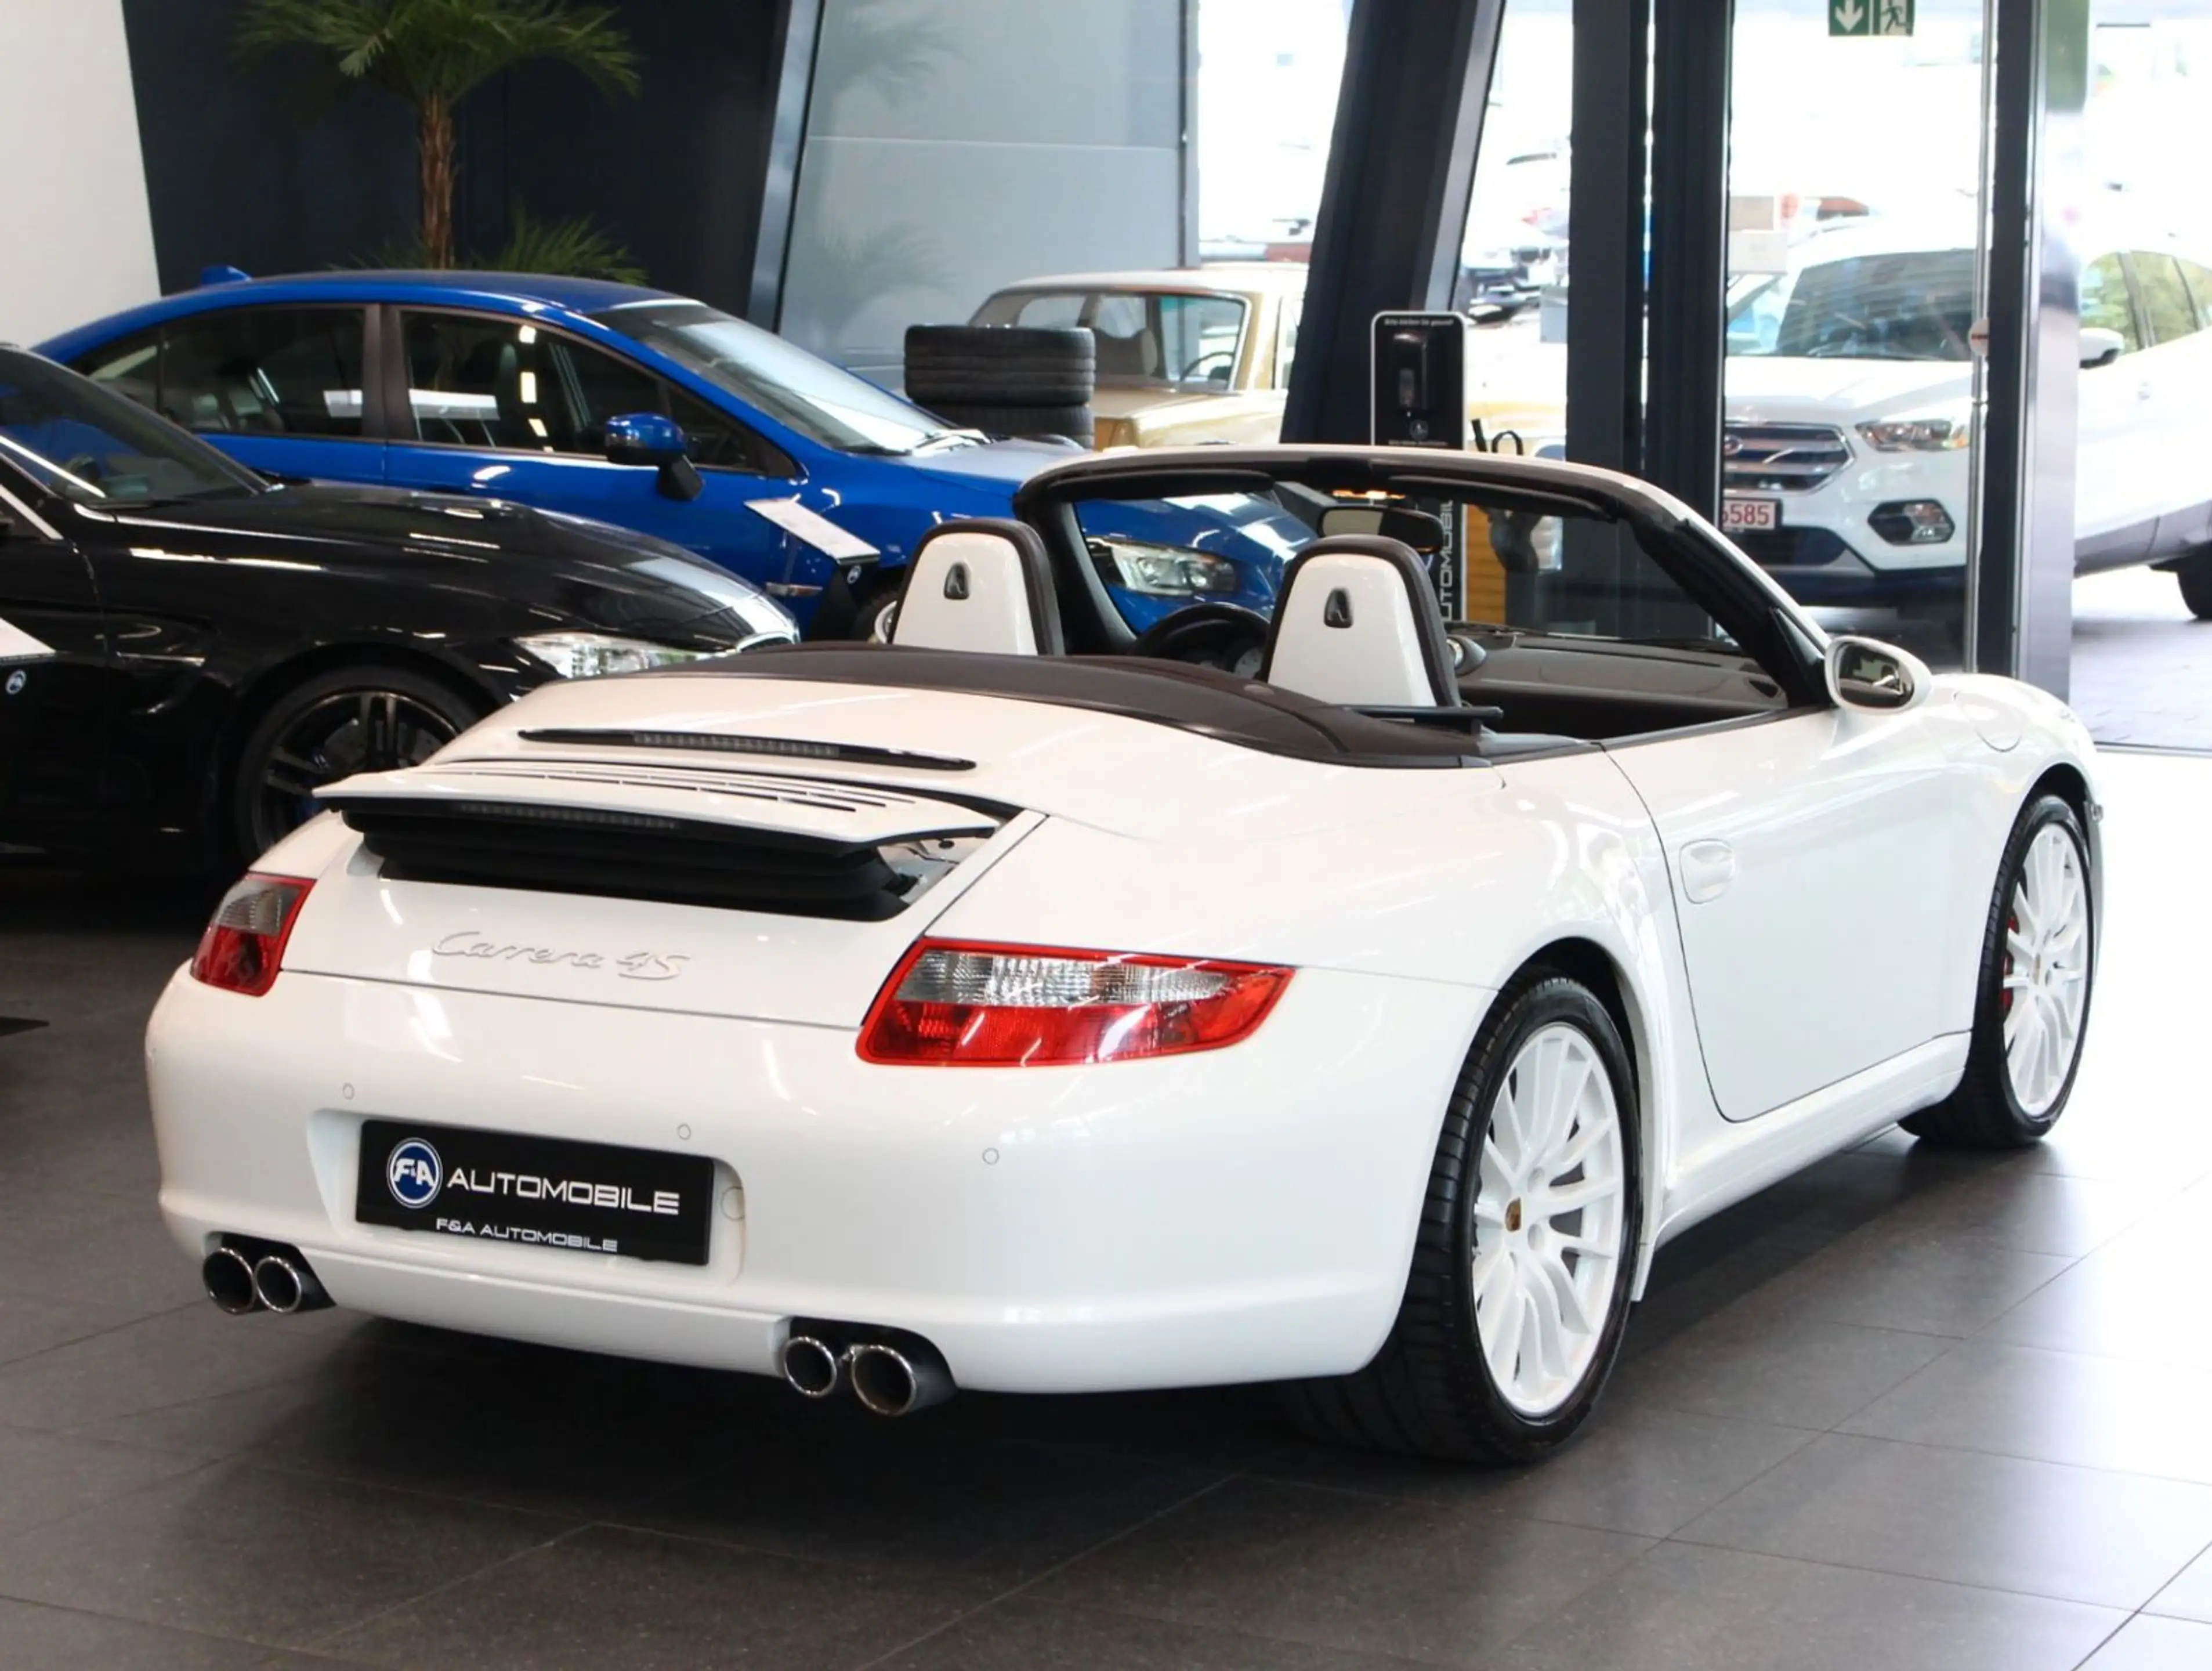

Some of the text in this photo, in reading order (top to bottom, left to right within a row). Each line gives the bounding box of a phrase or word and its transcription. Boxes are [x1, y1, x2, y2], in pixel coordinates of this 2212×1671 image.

[1440, 500, 1453, 623] UTOMOBIL
[432, 931, 691, 981] Carrera 4S
[447, 1167, 680, 1216] AUTOMOBILE
[436, 1217, 618, 1253] F&A AUTOMOBILE
